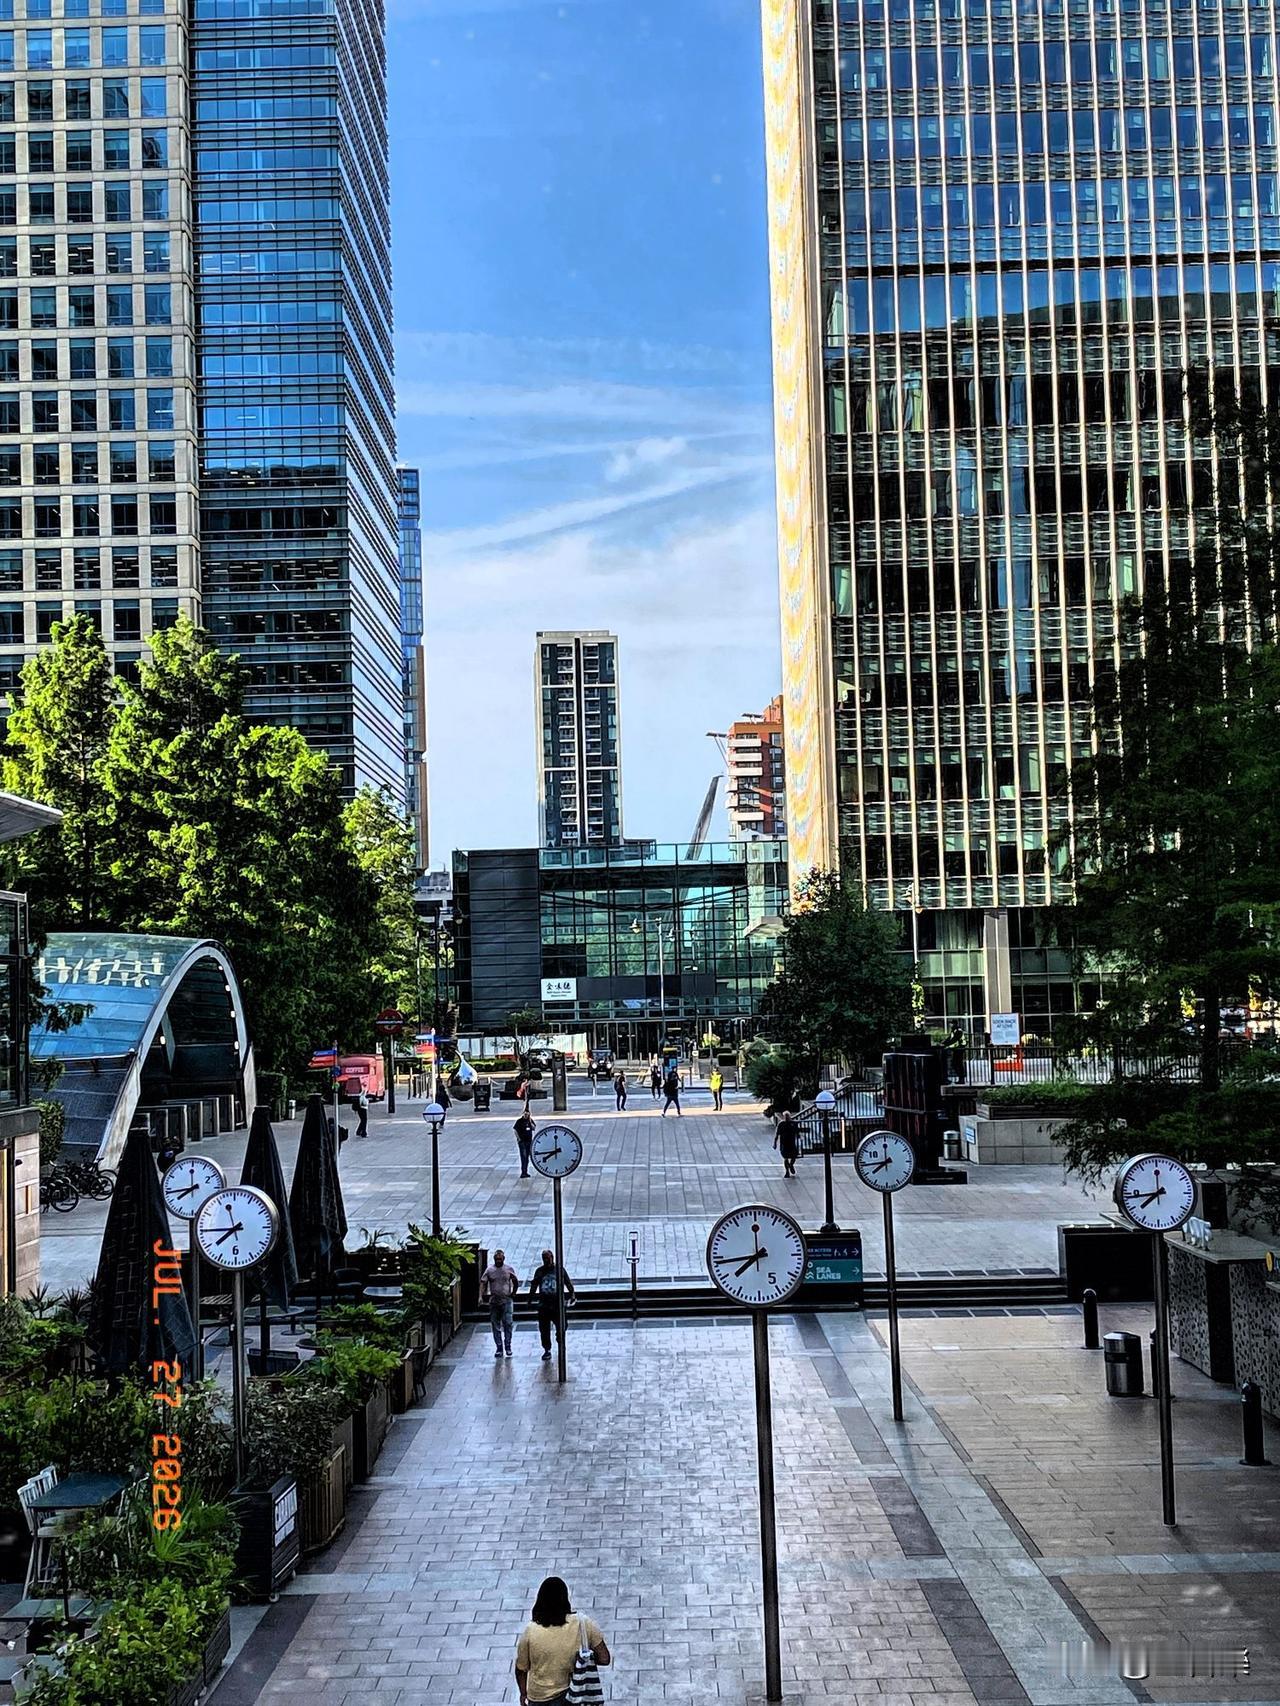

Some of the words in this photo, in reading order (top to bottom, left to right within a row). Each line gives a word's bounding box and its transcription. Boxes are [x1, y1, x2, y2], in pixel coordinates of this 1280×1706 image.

[345, 1066, 364, 1074] COFFEE
[869, 1150, 878, 1158] 10
[204, 1175, 211, 1184] 2
[232, 1245, 239, 1256] 6
[816, 1266, 832, 1274] SEA
[767, 1272, 777, 1285] 5
[816, 1272, 841, 1280] LANES
